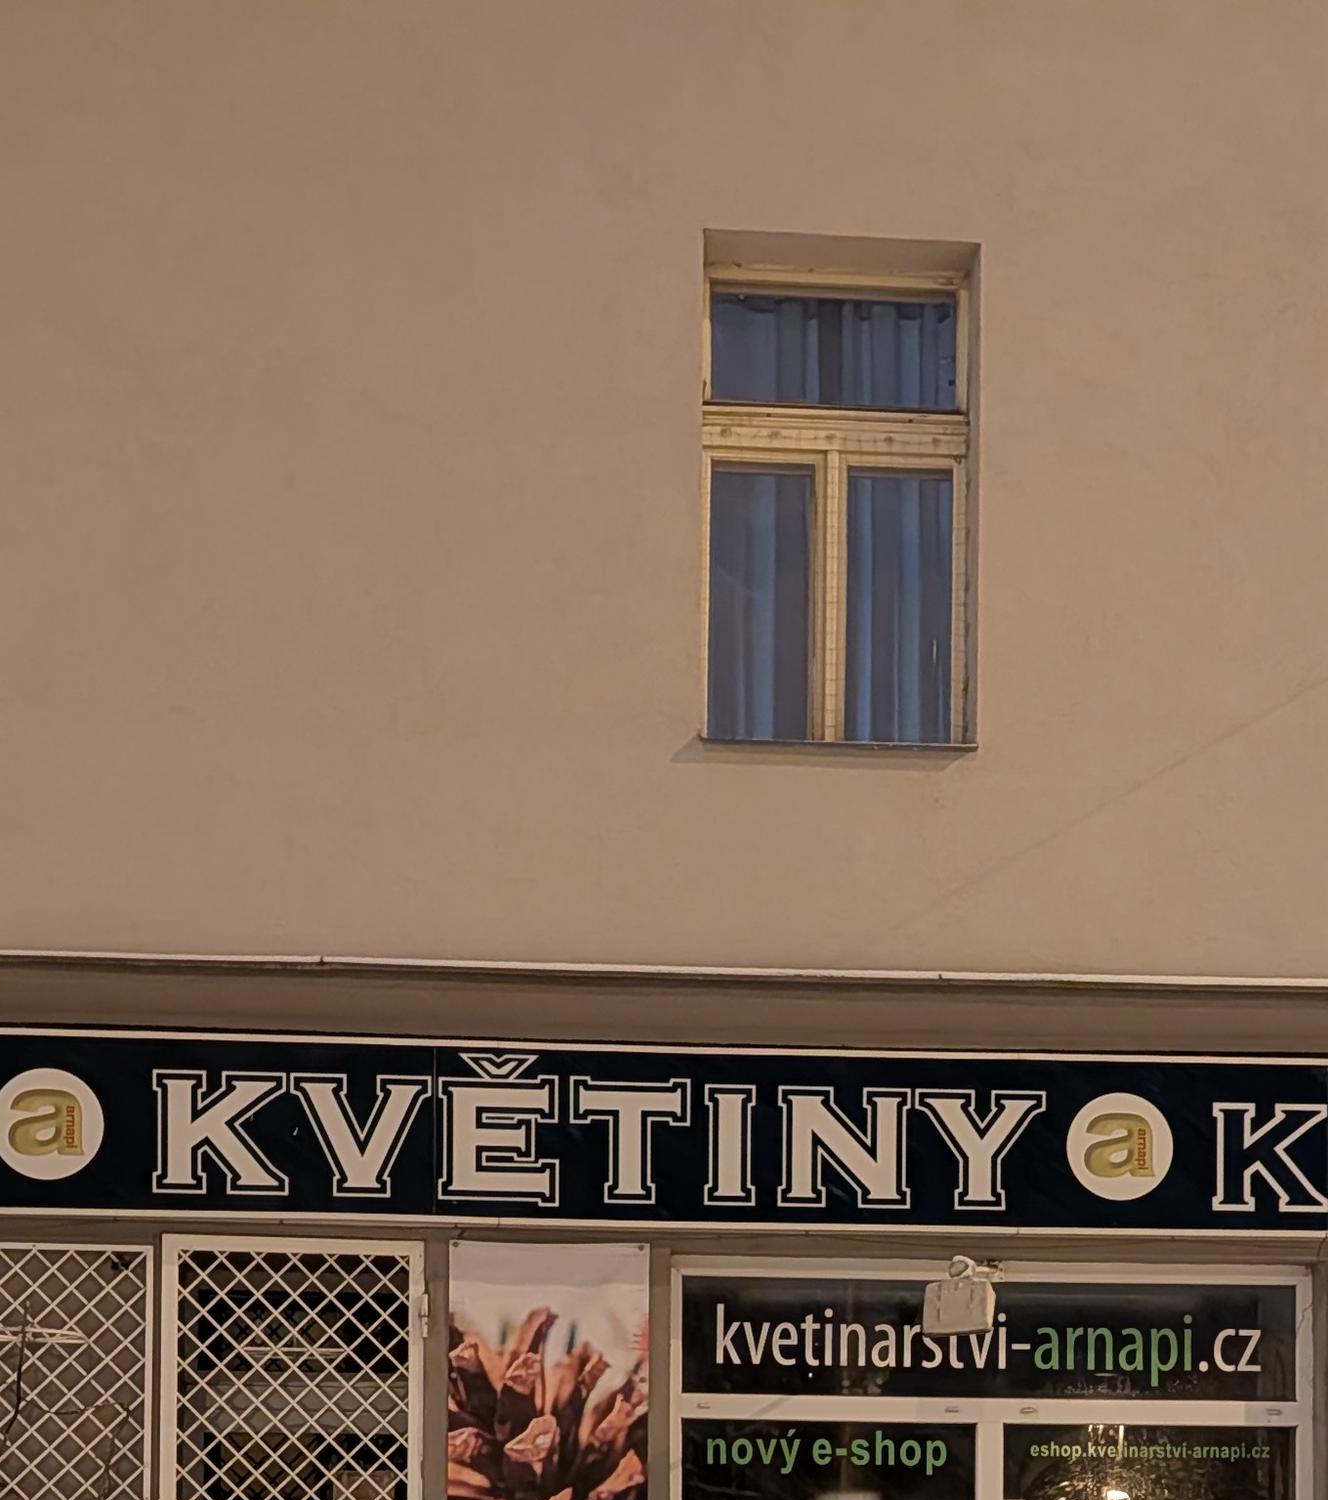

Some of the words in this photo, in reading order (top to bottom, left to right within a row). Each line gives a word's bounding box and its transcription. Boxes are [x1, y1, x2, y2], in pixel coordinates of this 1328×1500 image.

[152, 1052, 1048, 1212] KVĚTINY
[706, 1430, 800, 1475] nový
[812, 1430, 948, 1476] e-shop
[1030, 1441, 1271, 1463] eshop.kvetinarstvi-arnapi.cz
